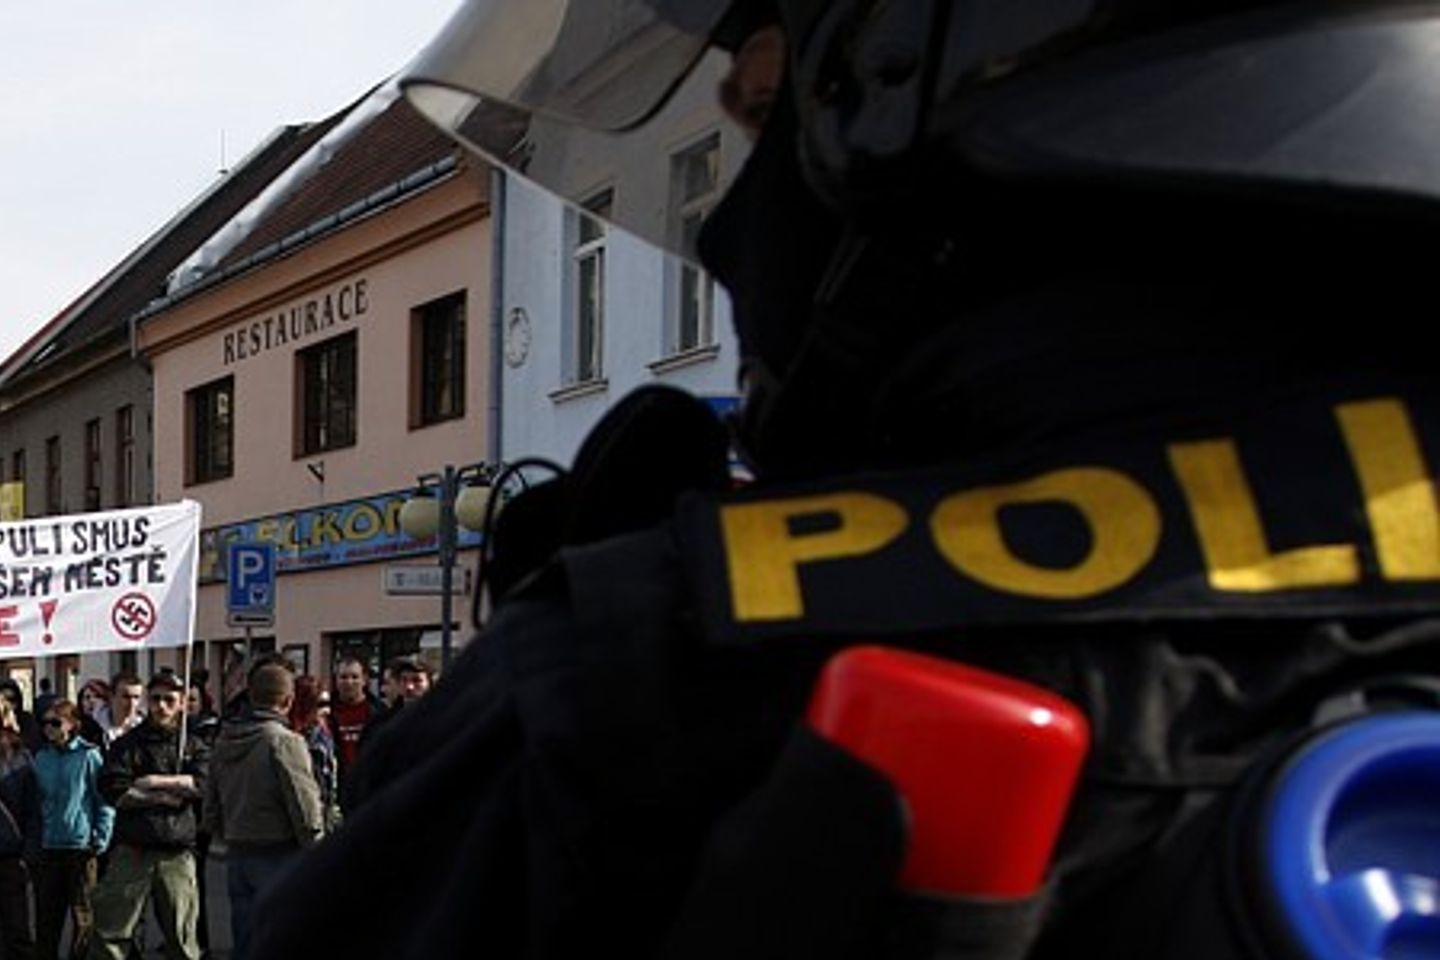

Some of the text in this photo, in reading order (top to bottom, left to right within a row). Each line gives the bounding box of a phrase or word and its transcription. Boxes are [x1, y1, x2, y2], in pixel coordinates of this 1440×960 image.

[222, 277, 369, 366] RESTAURACE
[720, 398, 1440, 620] POLI
[238, 550, 264, 590] P
